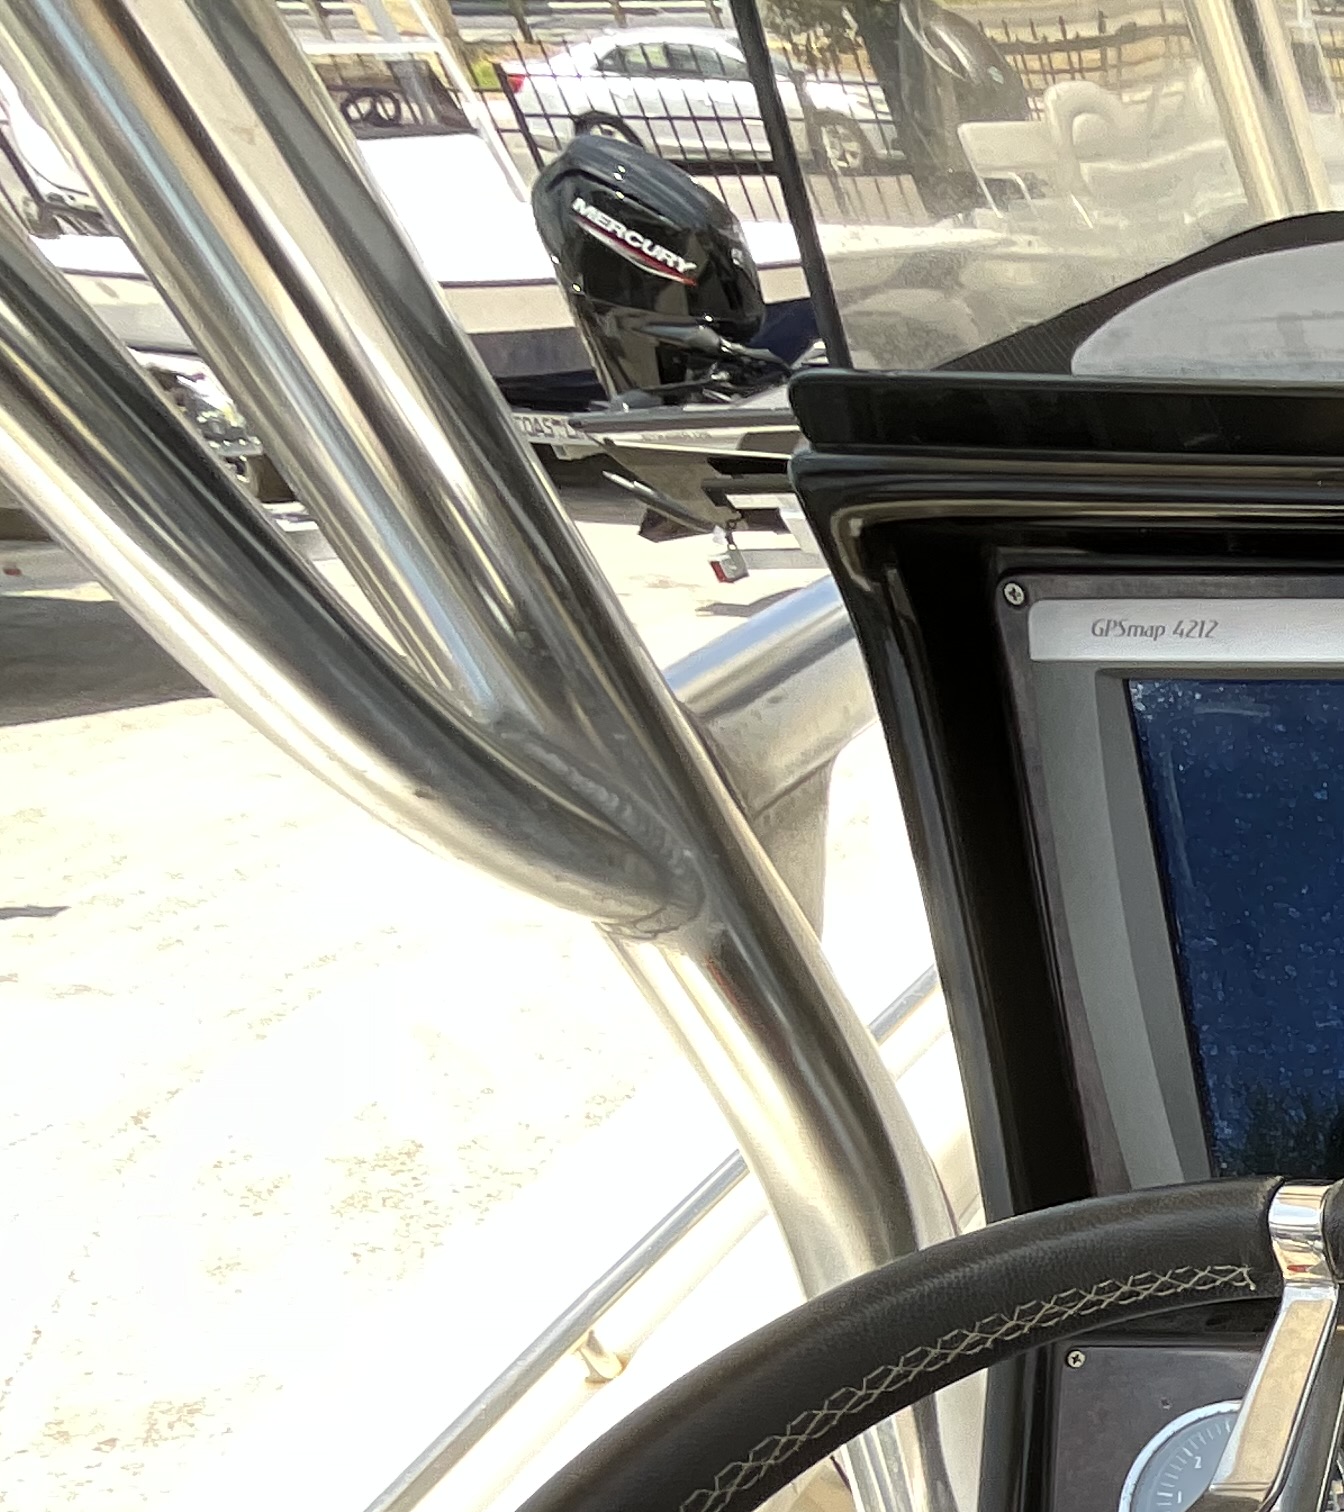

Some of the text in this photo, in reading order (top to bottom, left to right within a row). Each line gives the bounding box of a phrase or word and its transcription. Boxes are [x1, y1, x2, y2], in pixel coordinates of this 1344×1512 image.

[572, 196, 698, 274] MERCURY
[1091, 618, 1219, 641] GPSmap 4212
[1194, 1456, 1202, 1469] 2
[1177, 1490, 1182, 1504] 1
